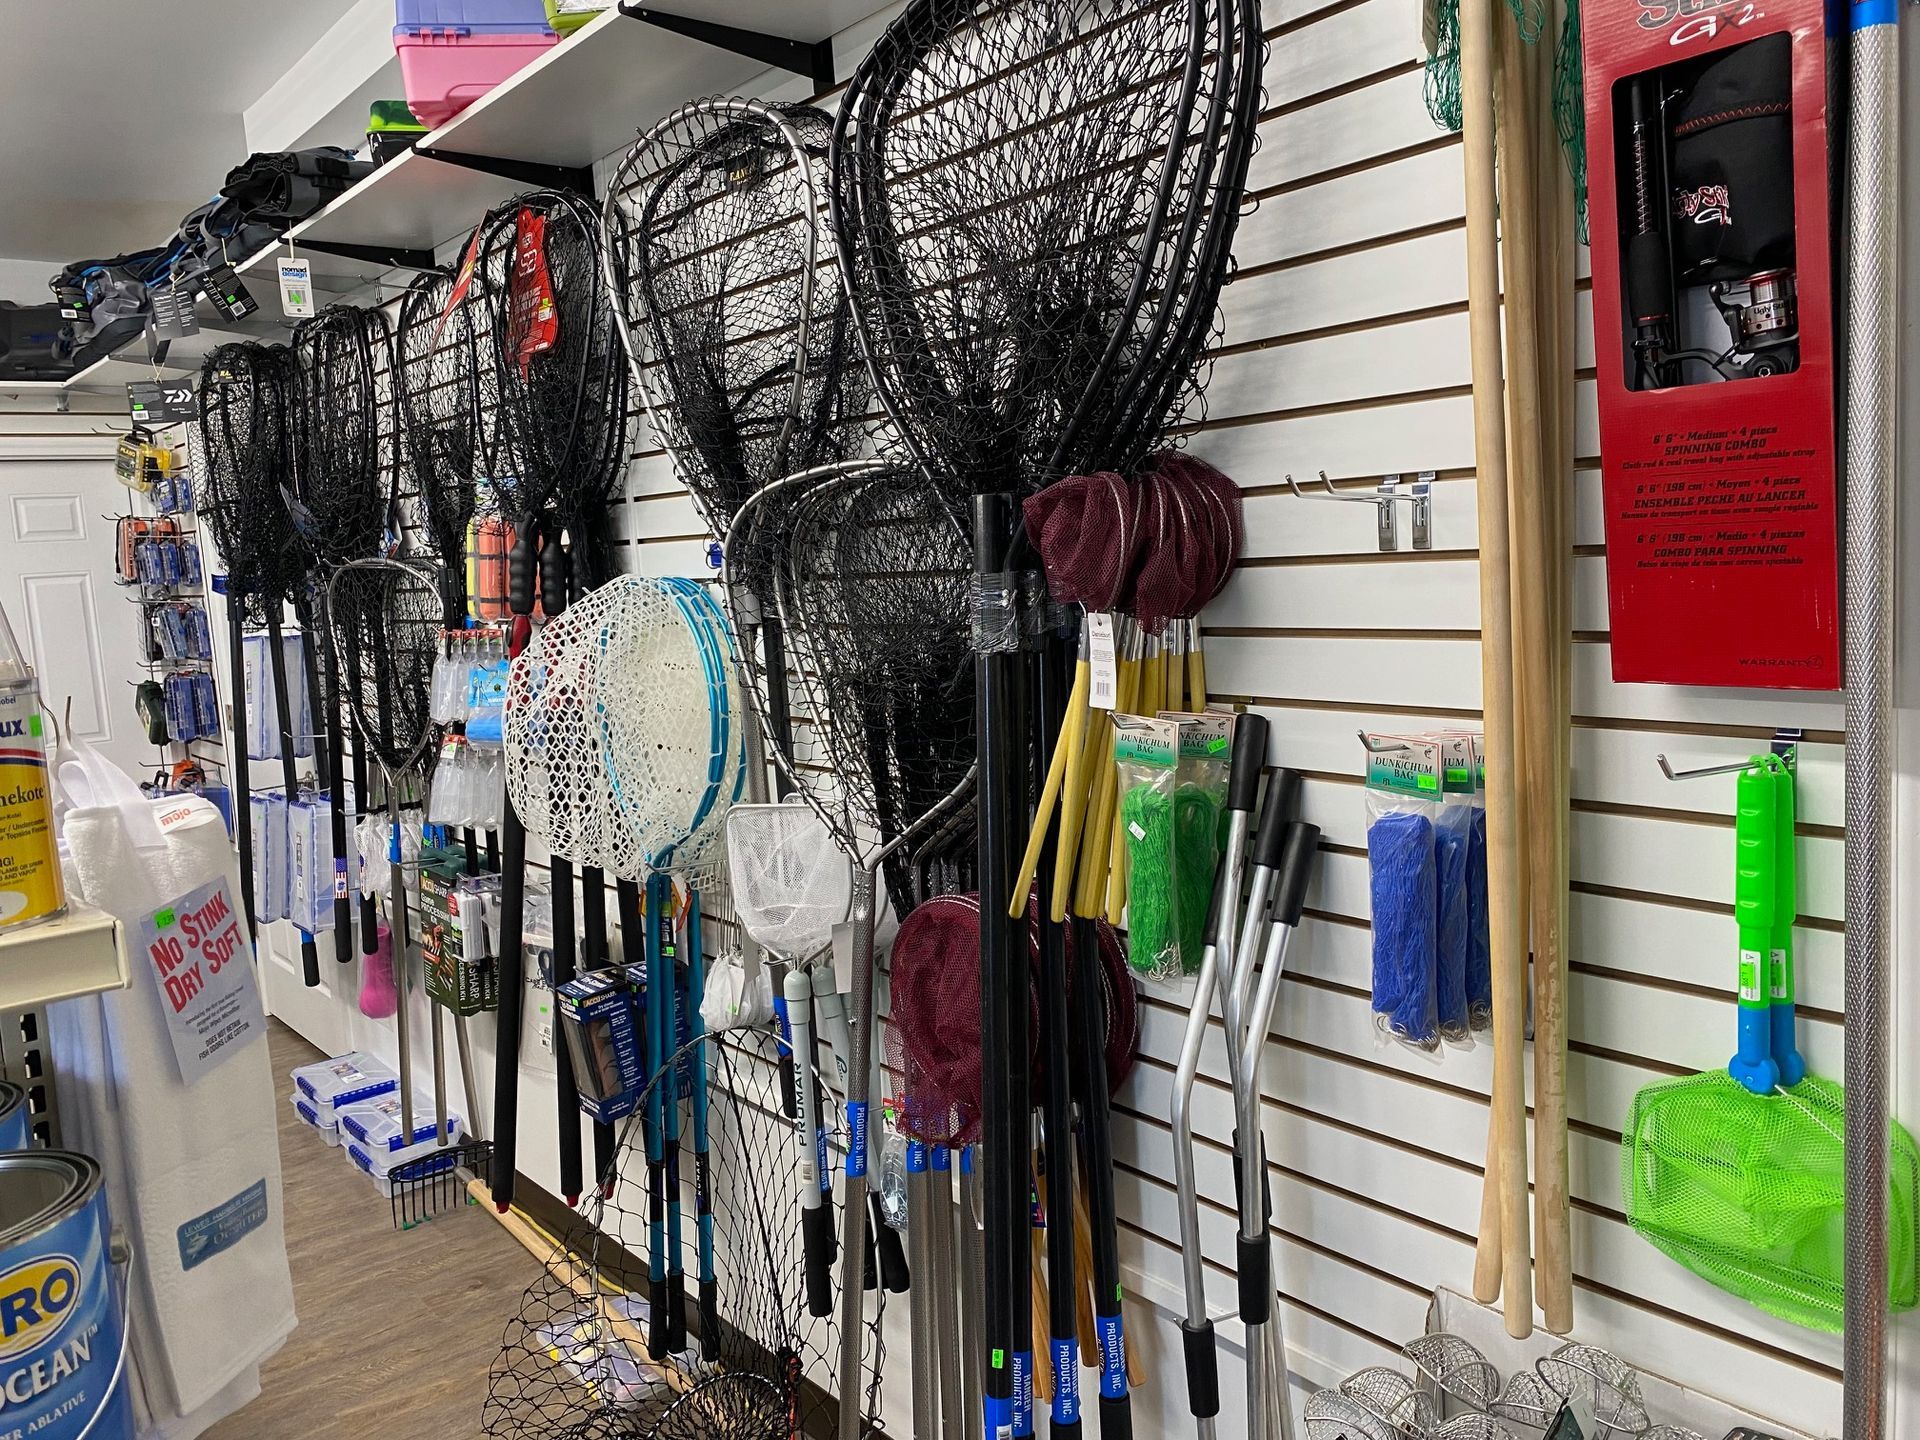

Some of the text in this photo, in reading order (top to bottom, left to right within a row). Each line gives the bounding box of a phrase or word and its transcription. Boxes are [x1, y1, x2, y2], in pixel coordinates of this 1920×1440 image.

[282, 271, 308, 279] design
[1686, 430, 1728, 441] Medium
[1739, 426, 1747, 436] 4
[1750, 426, 1778, 438] piece
[1664, 438, 1767, 457] SPINNING COMBO
[1726, 453, 1744, 462] with
[1745, 450, 1790, 461] adjustable
[1792, 448, 1816, 458] strap
[1716, 479, 1751, 490] Moyen
[1762, 477, 1769, 486] 4
[1634, 495, 1694, 509] ENSEMBLE
[1737, 492, 1755, 503] AU
[1757, 490, 1806, 501] LANCER
[1660, 508, 1697, 518] transport
[1716, 530, 1748, 541] Medio
[1759, 529, 1767, 539] 4
[1769, 529, 1805, 541] piezas
[1654, 544, 1787, 558] COMBO PARA SPINNING
[1121, 733, 1170, 749] DUNK/CHUM
[1136, 743, 1154, 754] BAG
[1183, 739, 1204, 748] BAG
[1375, 756, 1433, 774] DUNK/CHUM
[1394, 768, 1414, 781] BAG
[160, 808, 191, 827] mojo
[198, 1048, 210, 1061] FISH
[209, 1038, 225, 1054] ODORS
[224, 1032, 234, 1043] LIKE
[205, 1034, 218, 1047] DOES
[217, 1028, 226, 1039] NOT
[794, 1063, 808, 1146] PROMAR
[855, 1106, 866, 1173] PRODUCTS, INC.
[913, 1150, 923, 1168] INC.
[1106, 1322, 1122, 1393] PRODUCTS, INC.
[1060, 1345, 1073, 1418] PRODUCTS, INC.
[1023, 1373, 1033, 1413] RANGER
[28, 1390, 86, 1435] ABLATIVE
